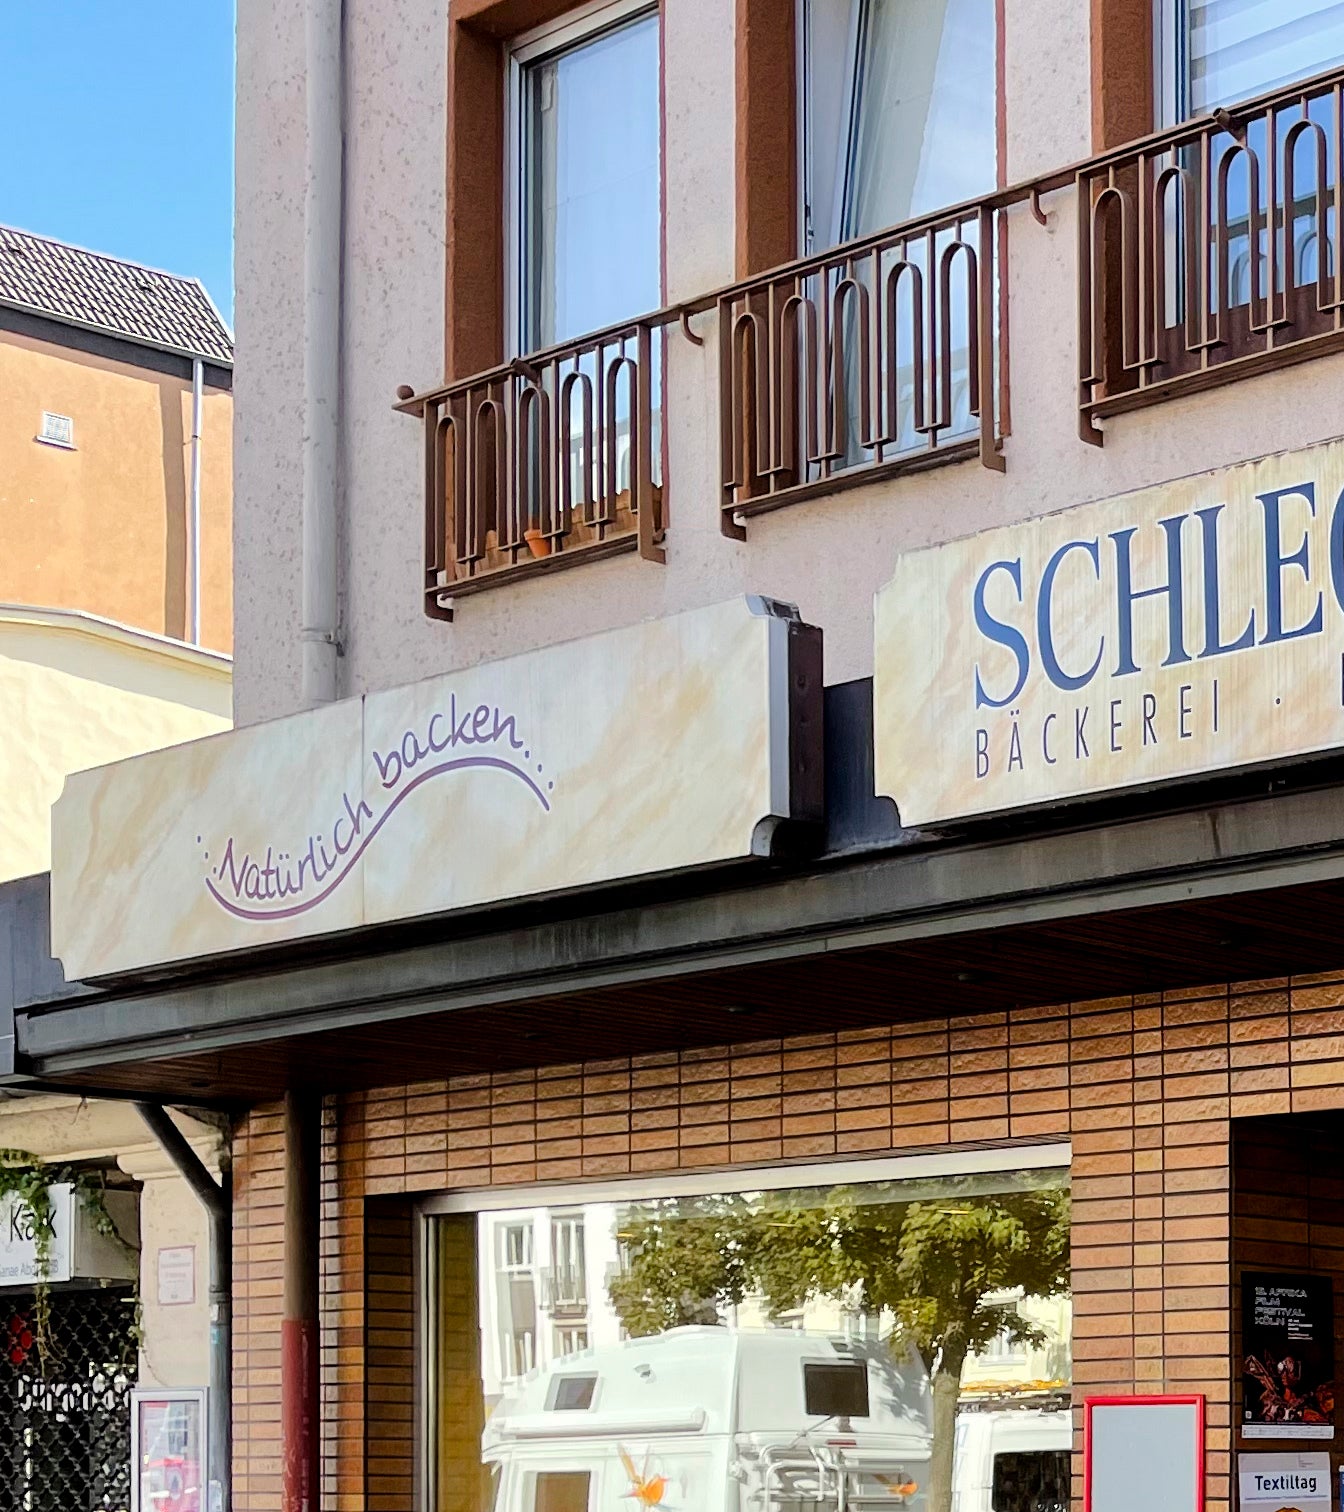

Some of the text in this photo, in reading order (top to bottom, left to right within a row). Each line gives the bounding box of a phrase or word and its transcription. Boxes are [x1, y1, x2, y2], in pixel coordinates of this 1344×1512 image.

[975, 687, 1224, 781] BÄCKEREI
[218, 790, 372, 903] Natürlich
[1254, 1296, 1281, 1307] FILM
[1254, 1306, 1306, 1317] FESTIVAL
[1254, 1314, 1285, 1326] KÖLN
[1254, 1474, 1317, 1493] Textiltag
